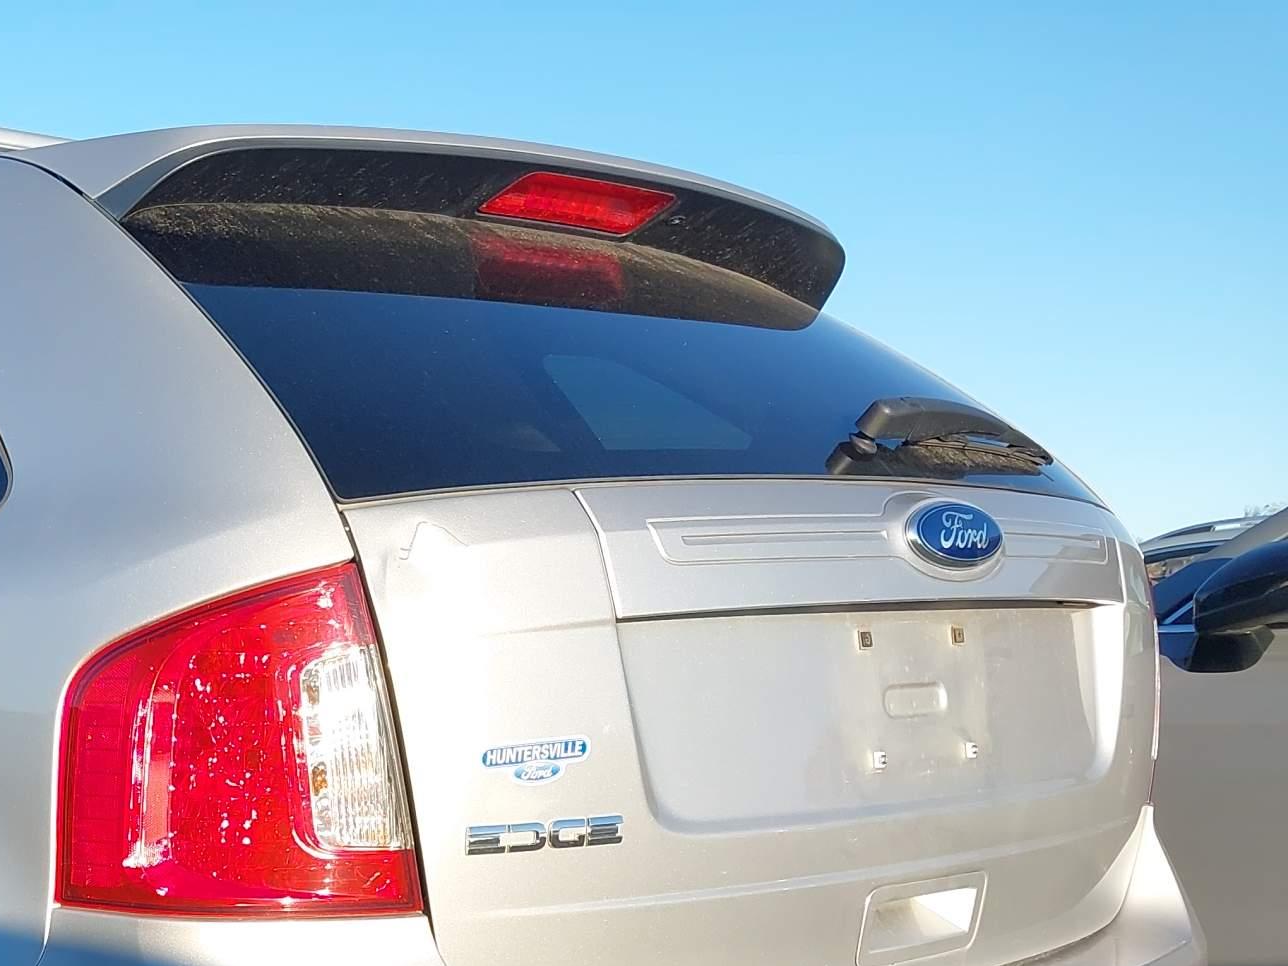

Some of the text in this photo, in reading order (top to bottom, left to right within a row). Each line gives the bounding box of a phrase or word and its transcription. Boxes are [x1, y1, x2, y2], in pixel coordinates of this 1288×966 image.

[940, 511, 990, 549] Ford
[485, 740, 584, 766] HUNTERSVILLE
[521, 763, 553, 780] Ford
[465, 814, 624, 856] EDGE
